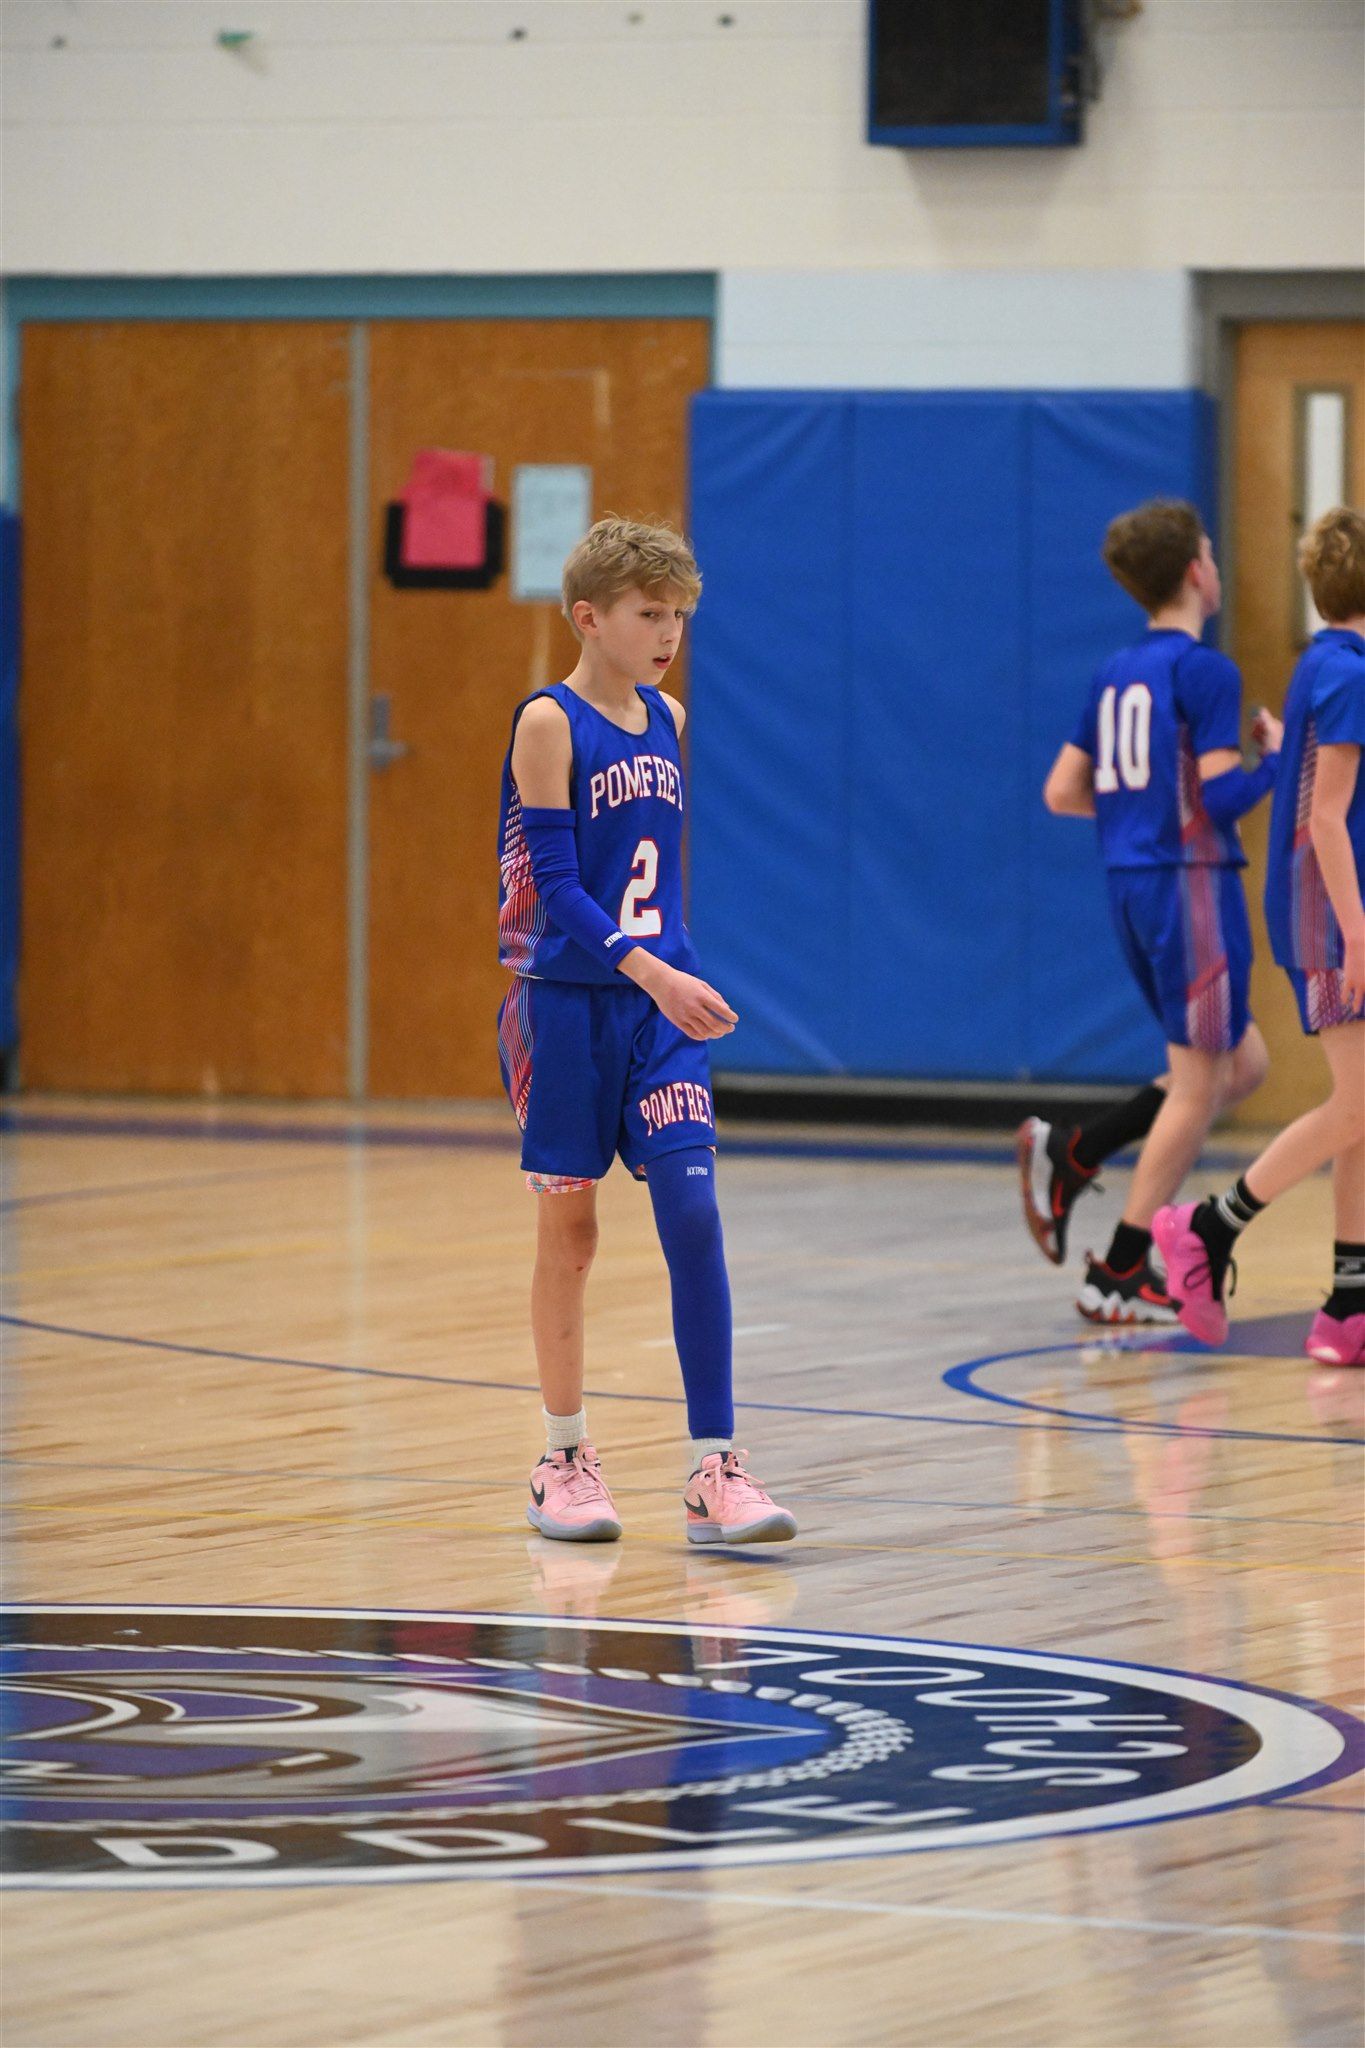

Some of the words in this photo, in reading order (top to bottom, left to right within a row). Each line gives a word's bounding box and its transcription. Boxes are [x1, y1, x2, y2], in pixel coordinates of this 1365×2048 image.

[590, 755, 683, 820] POMFRET
[1095, 683, 1152, 793] 10
[619, 838, 663, 938] 2
[639, 1082, 714, 1137] POMFRET
[696, 1647, 1189, 1787] SCHOOL
